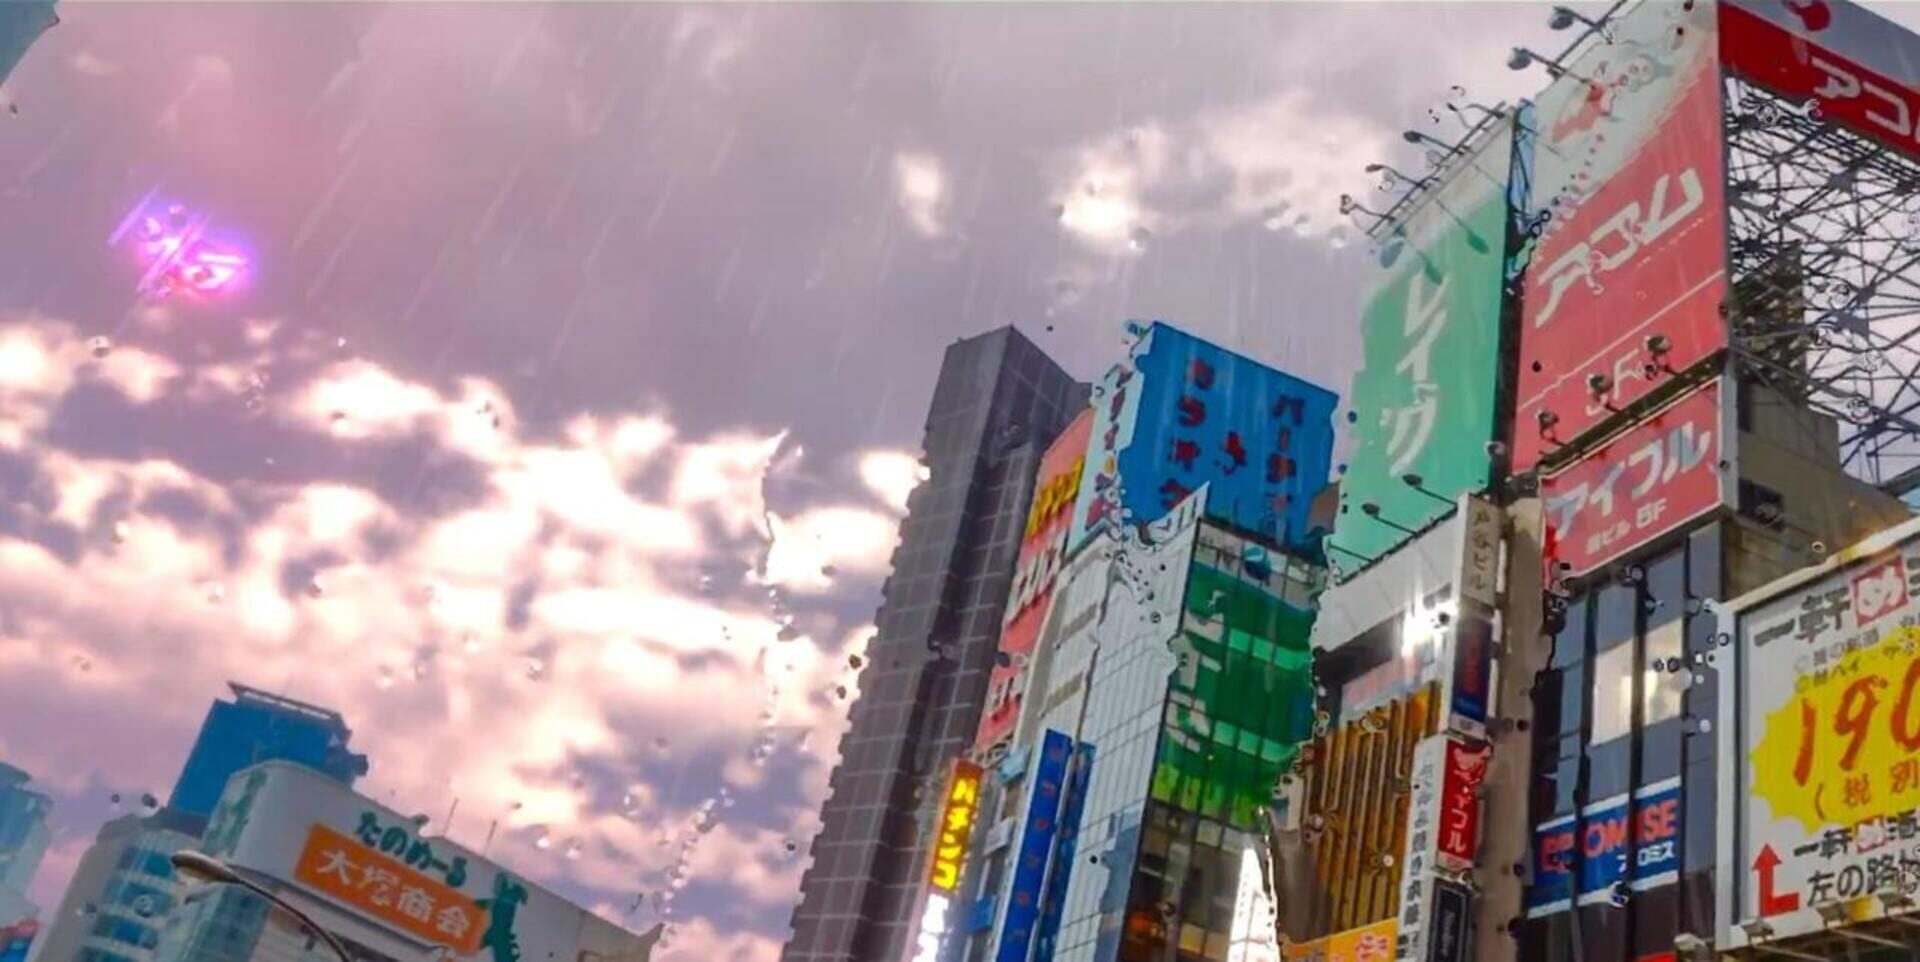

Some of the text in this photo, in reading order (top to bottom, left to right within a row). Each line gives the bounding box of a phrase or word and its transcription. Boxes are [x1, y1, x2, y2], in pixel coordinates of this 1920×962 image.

[1810, 54, 1920, 146] アコ
[1535, 167, 1704, 328] アコム
[1544, 421, 1712, 541] アイフル
[356, 811, 468, 888] たのめーる
[938, 778, 978, 890] パチンコ
[1541, 798, 1678, 874] POMSE
